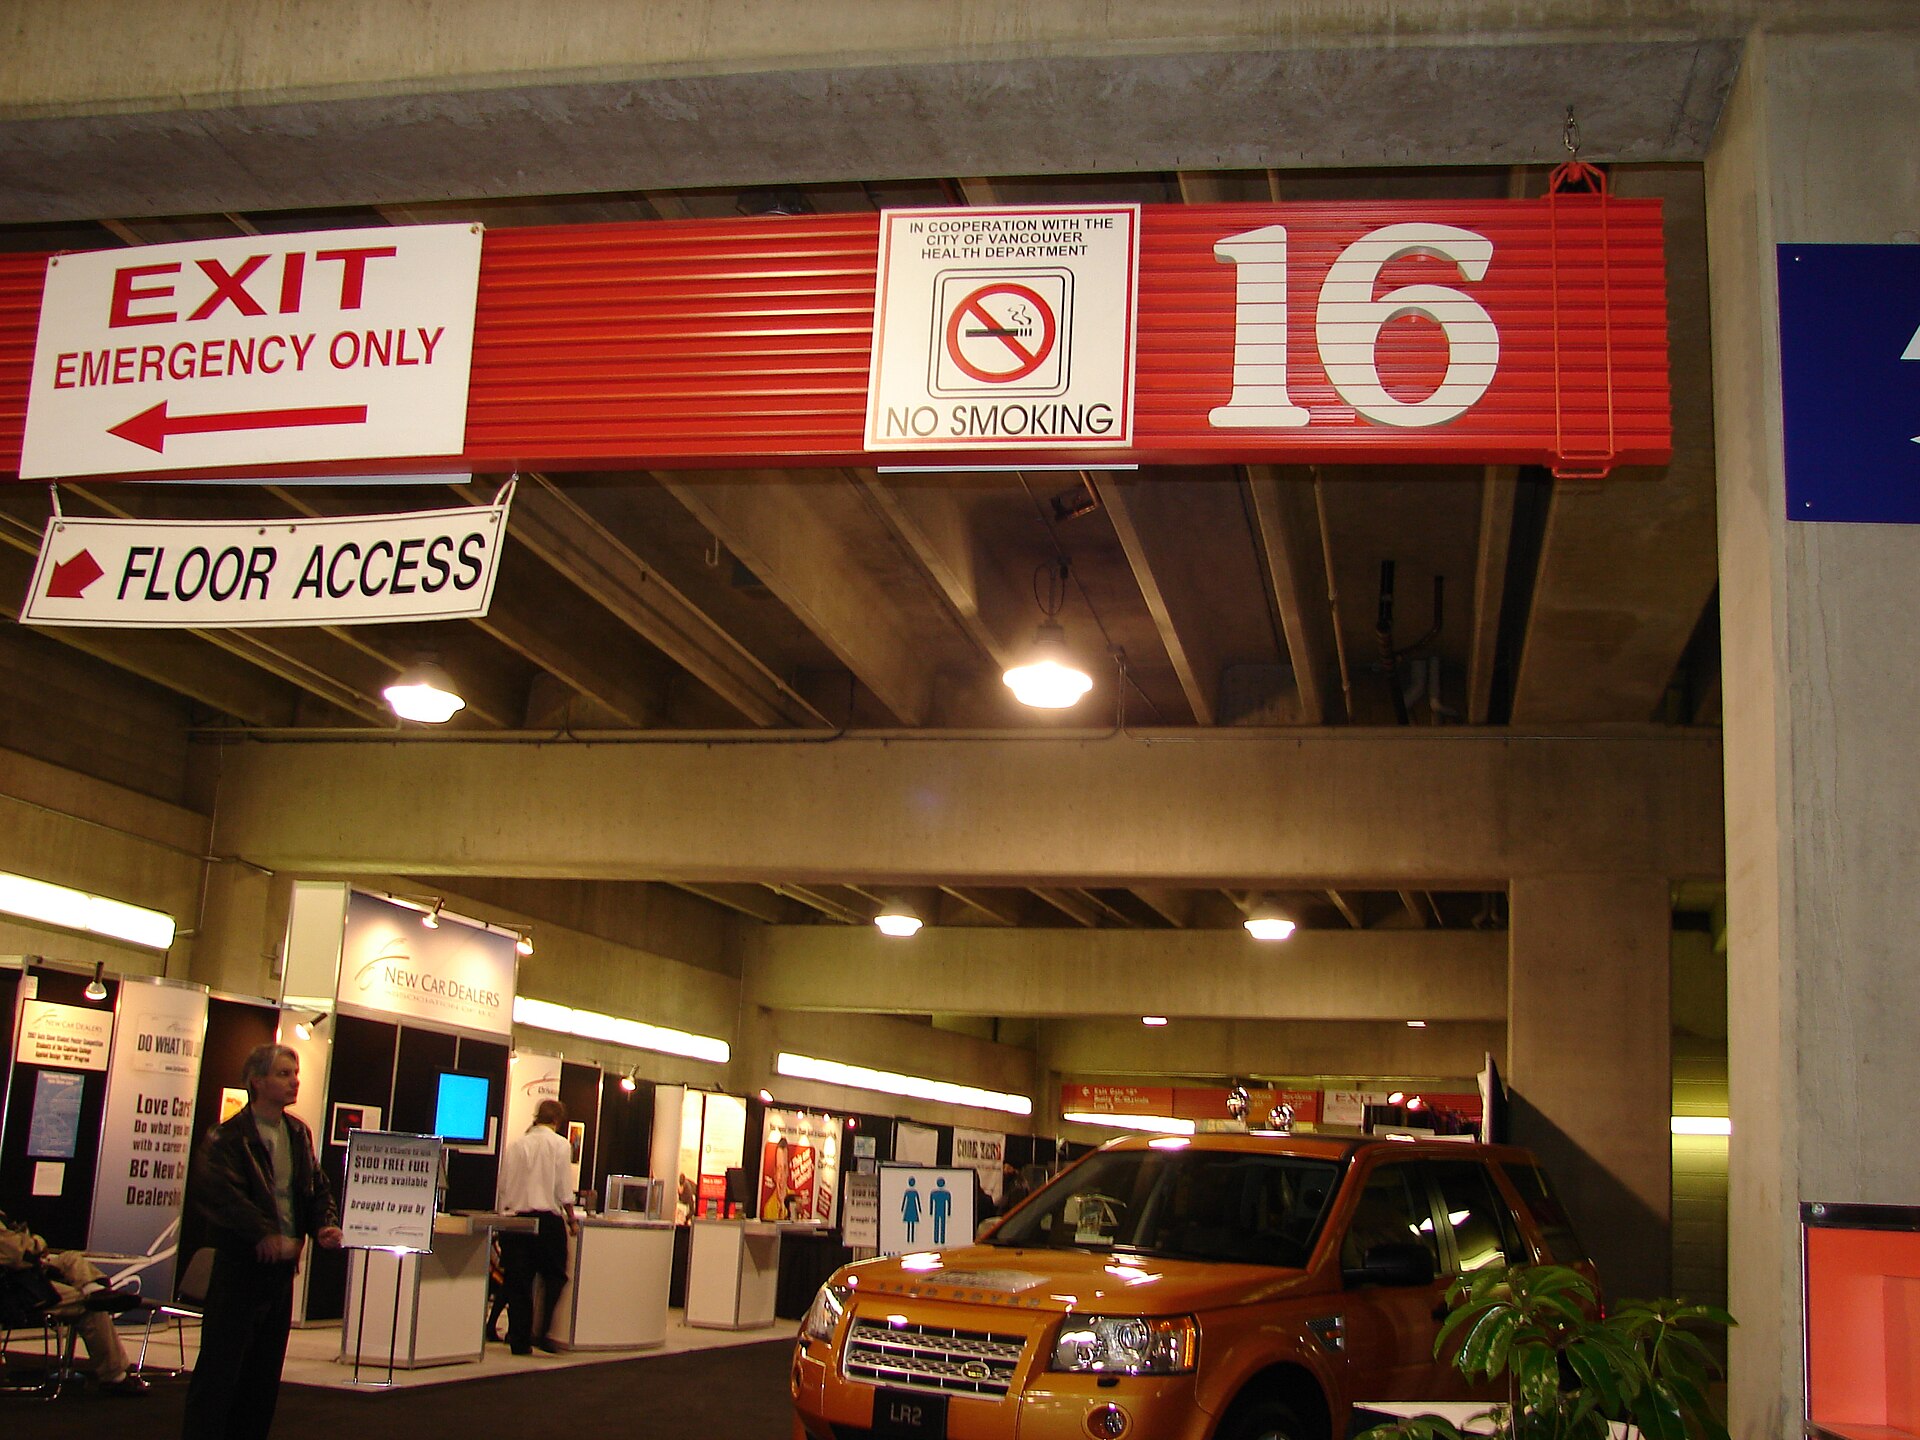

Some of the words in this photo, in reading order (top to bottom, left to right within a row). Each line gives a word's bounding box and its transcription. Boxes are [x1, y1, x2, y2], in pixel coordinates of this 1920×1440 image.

[910, 223, 923, 234] IN
[928, 221, 1037, 233] COOPERATION
[1042, 219, 1080, 231] WITH
[1084, 218, 1114, 230] THE
[926, 234, 959, 246] CITY
[964, 233, 983, 244] OF
[988, 232, 1083, 244] VANCOUVER
[921, 247, 980, 259] HEALTH
[985, 245, 1088, 258] DEPARTMENT
[109, 246, 397, 328] EXIT
[1208, 222, 1500, 427] 16
[53, 333, 316, 389] EMERGENCY
[329, 327, 445, 370] ONLY
[886, 405, 939, 436] NO
[951, 404, 1114, 435] SMOKING
[117, 546, 278, 602] FLOOR
[293, 532, 486, 600] ACCESS
[385, 966, 418, 988] NEW
[421, 974, 446, 996] CAR
[448, 980, 500, 1008] DEALERS
[138, 1034, 153, 1051] DO
[155, 1035, 181, 1055] WHAT
[136, 1093, 168, 1116] Love
[134, 1119, 147, 1133] Do
[151, 1121, 171, 1136] what
[133, 1139, 153, 1151] with
[956, 1138, 978, 1158] CODE
[980, 1140, 1002, 1161] ZERO
[129, 1159, 149, 1178] BC
[153, 1160, 175, 1179] New
[383, 1158, 405, 1172] FREE
[408, 1160, 430, 1173] FUEL
[362, 1174, 388, 1185] prizes
[391, 1175, 428, 1188] available
[351, 1199, 385, 1212] brought
[387, 1201, 396, 1212] to
[398, 1203, 414, 1214] you
[415, 1203, 426, 1216] by
[890, 1402, 923, 1426] LR2
